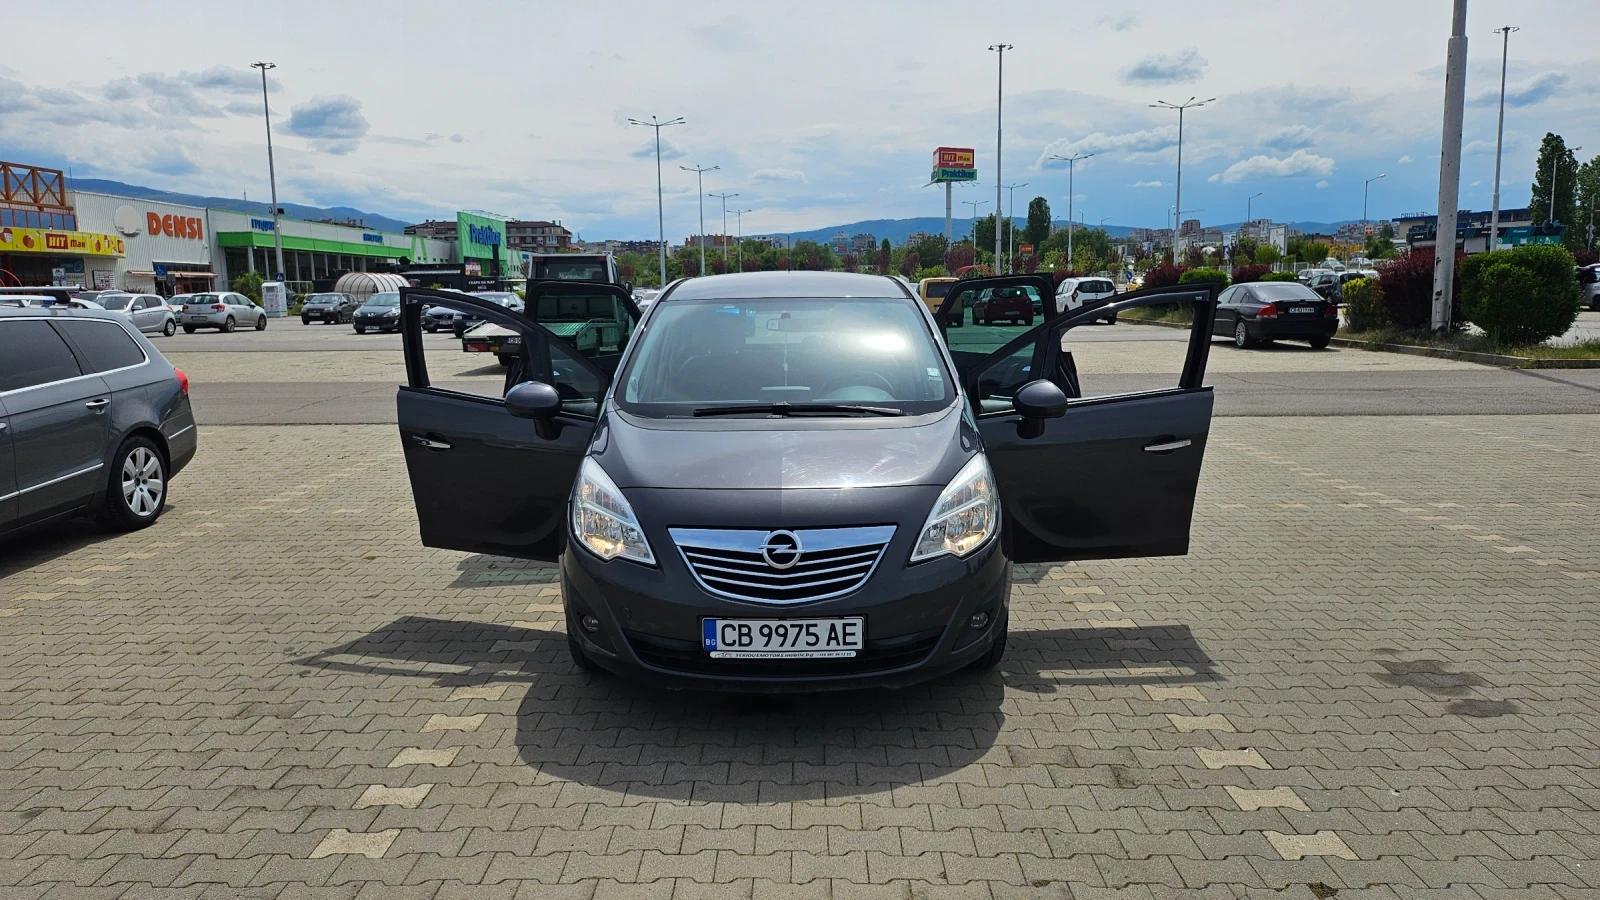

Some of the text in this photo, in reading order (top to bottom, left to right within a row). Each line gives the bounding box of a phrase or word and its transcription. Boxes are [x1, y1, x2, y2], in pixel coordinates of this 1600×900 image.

[147, 211, 203, 240] DENSI
[49, 236, 66, 248] HIT
[705, 622, 858, 647] BG CB 9975 AE
